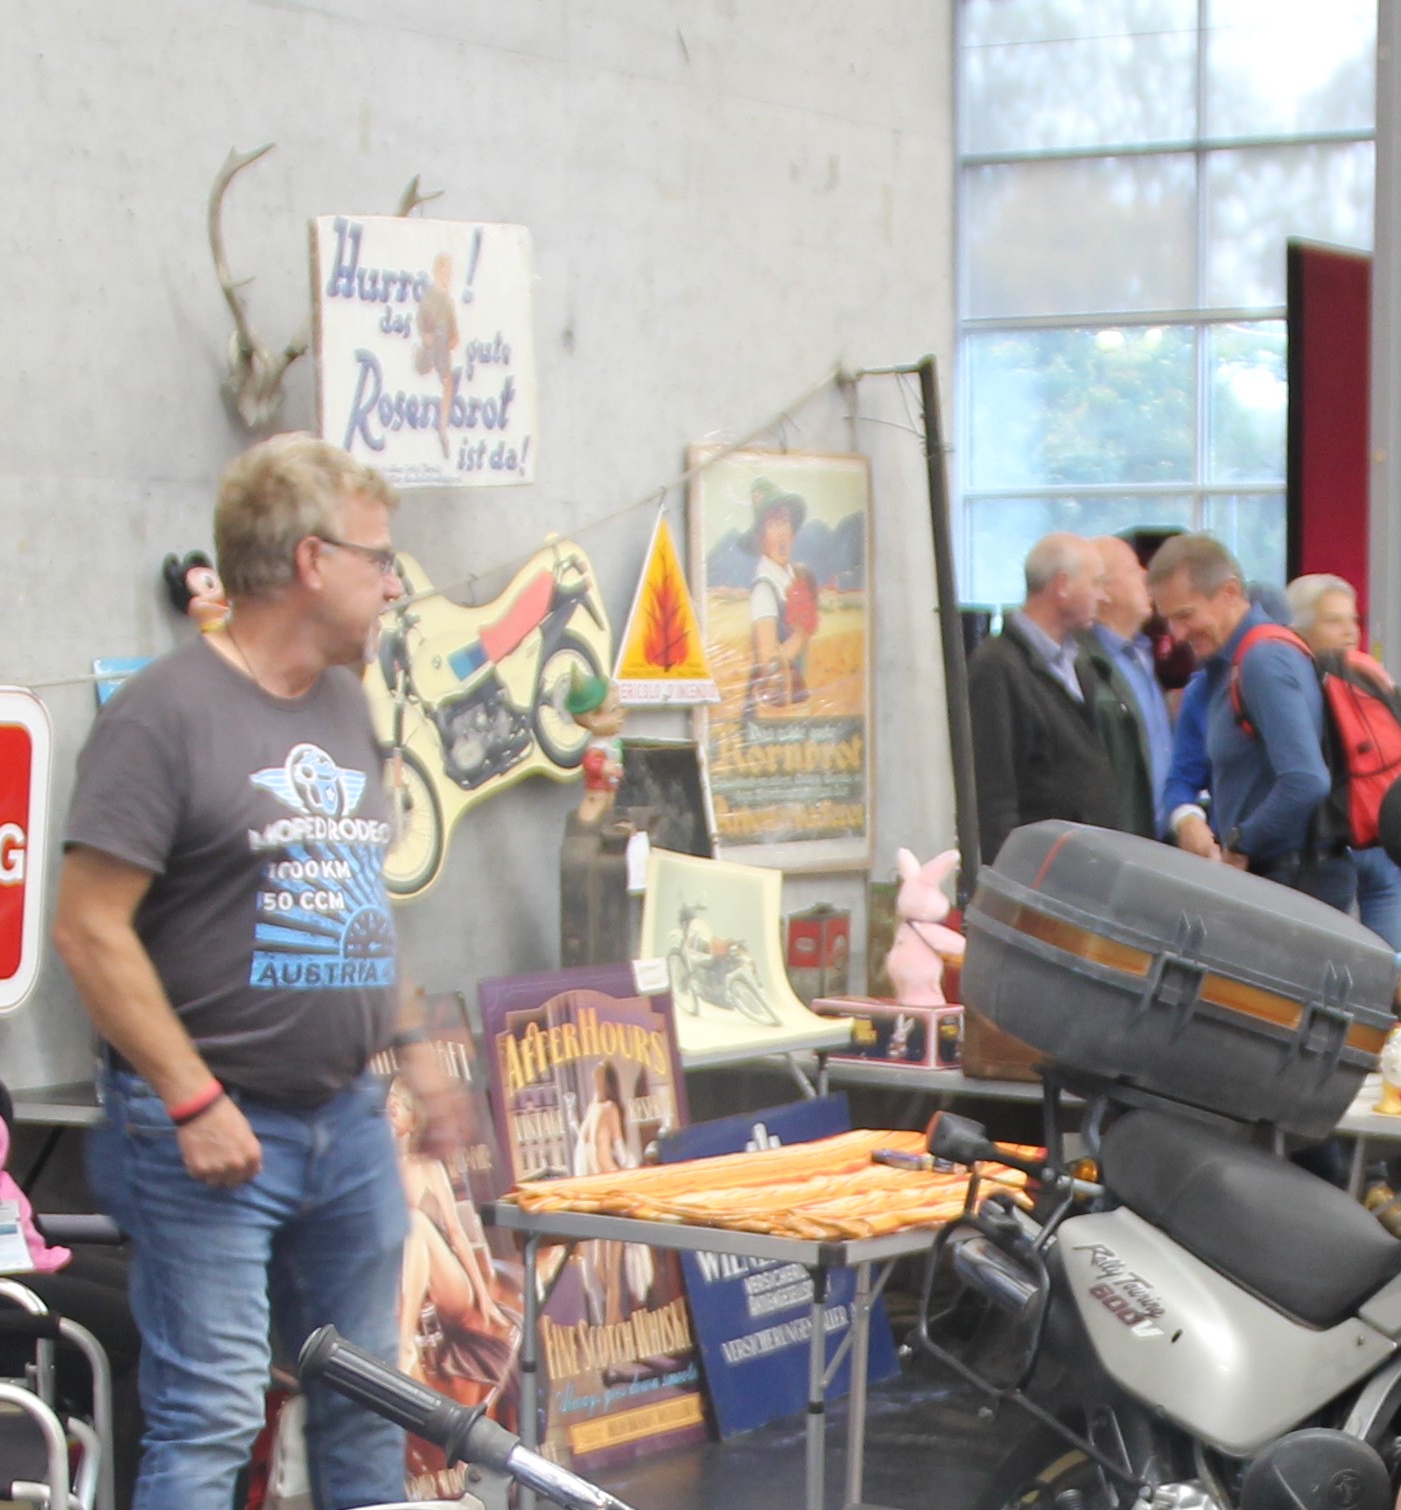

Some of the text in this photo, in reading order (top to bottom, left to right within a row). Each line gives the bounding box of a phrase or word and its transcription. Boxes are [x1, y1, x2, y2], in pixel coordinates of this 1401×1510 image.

[262, 891, 346, 912] 50 CCM
[258, 961, 378, 987] AUSTRIA
